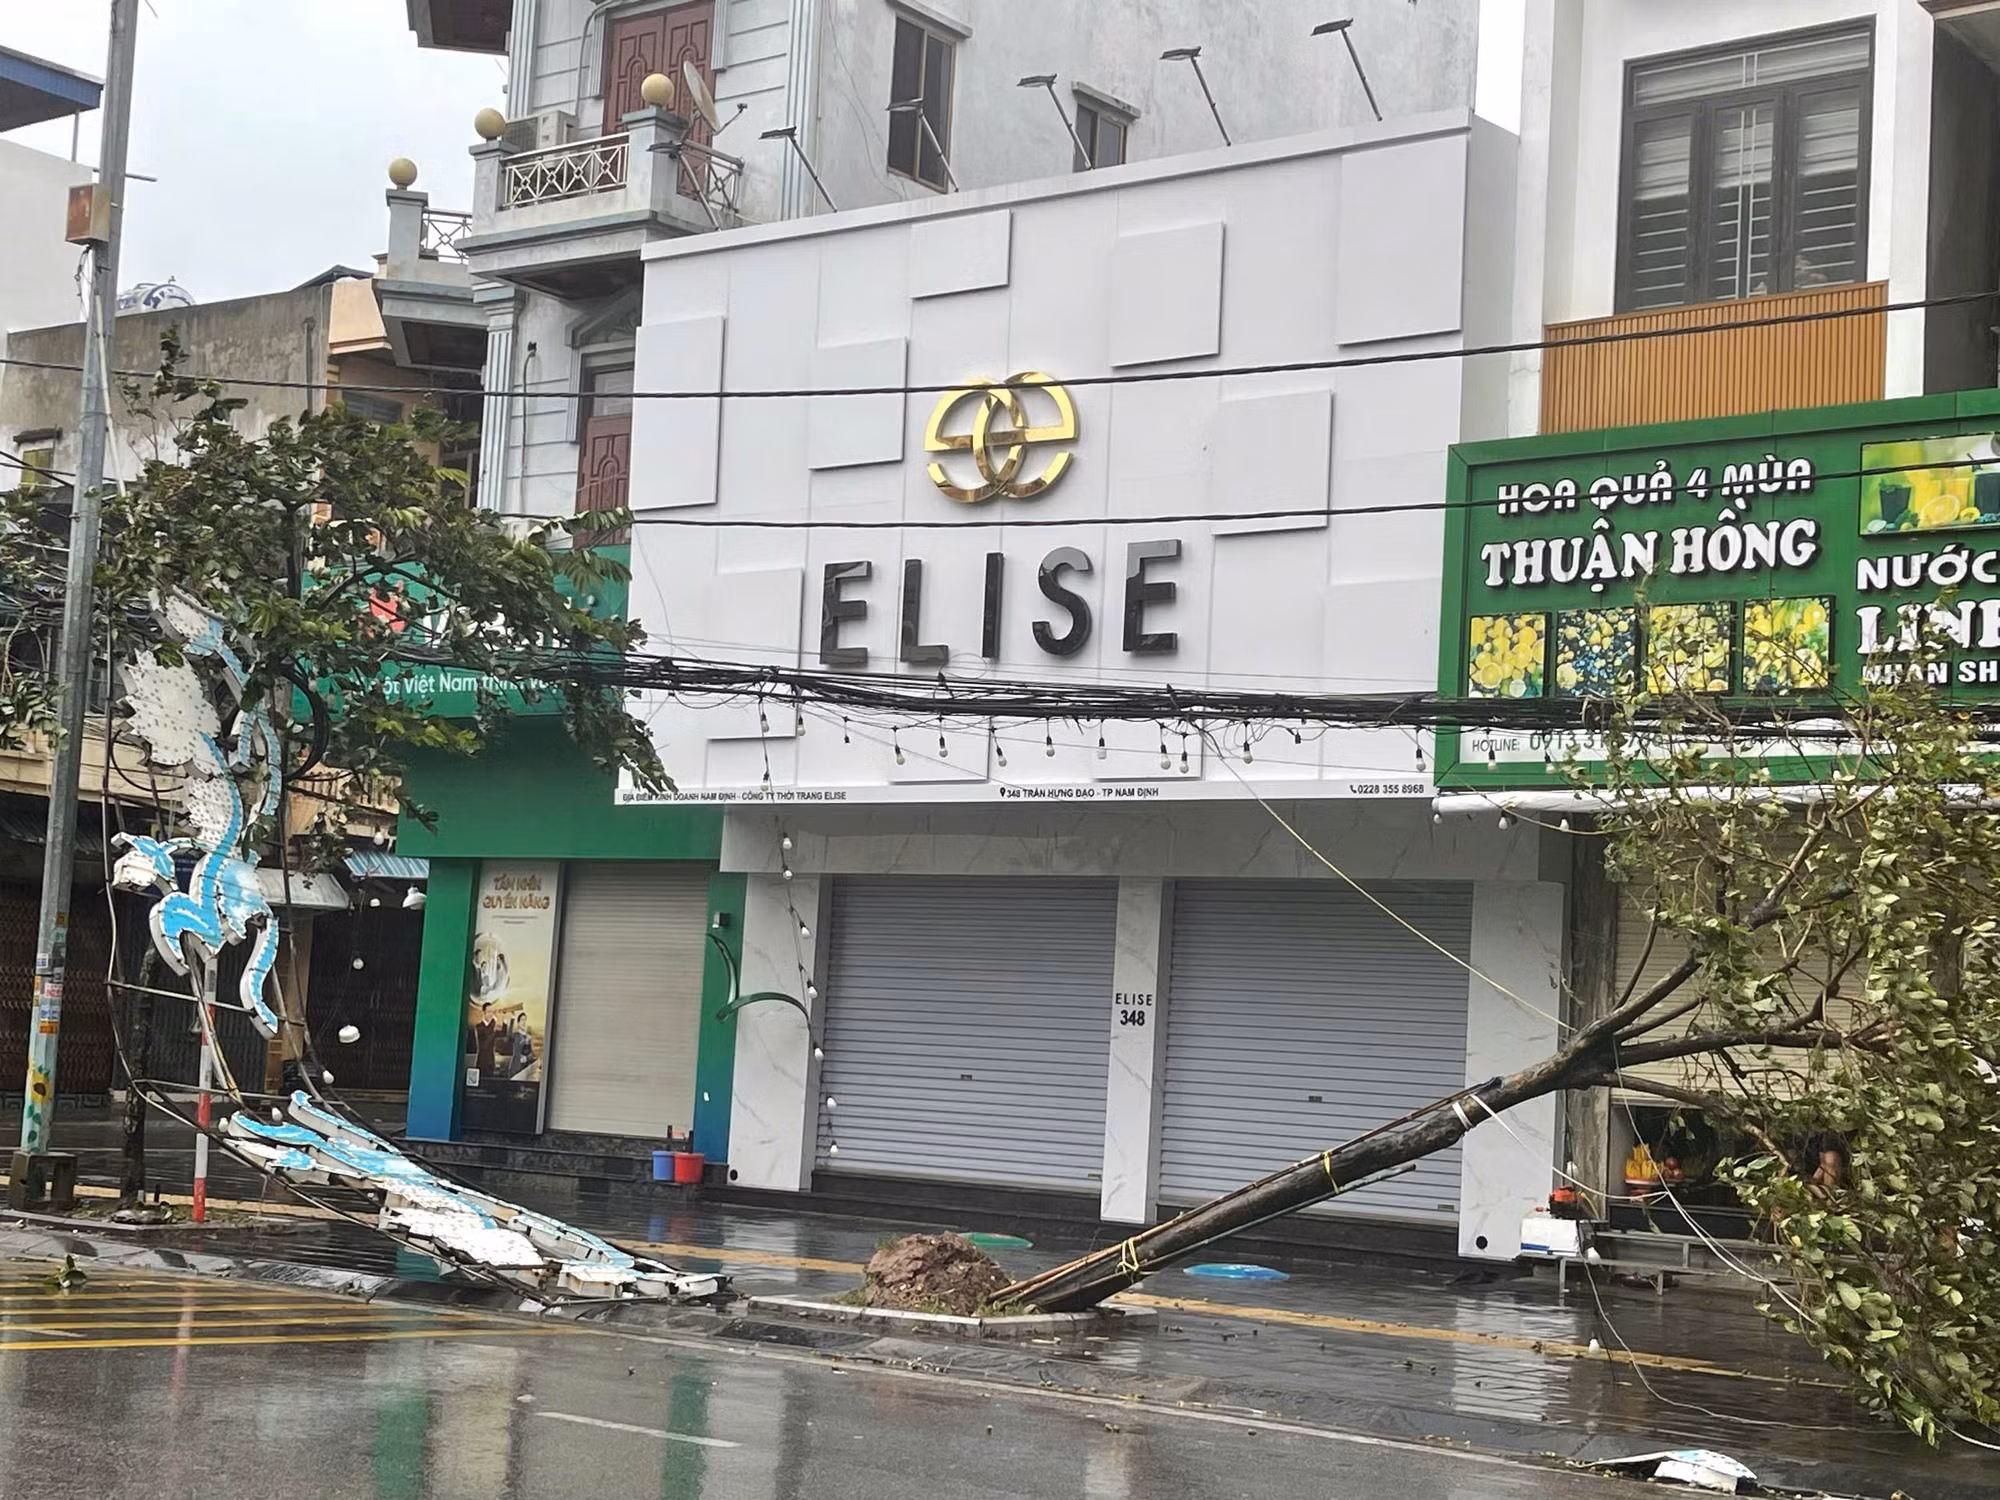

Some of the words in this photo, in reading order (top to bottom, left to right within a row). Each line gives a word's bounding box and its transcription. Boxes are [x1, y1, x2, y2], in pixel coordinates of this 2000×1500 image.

[1498, 478, 1577, 514] HOA
[1589, 460, 1673, 510] QUẢ
[1687, 468, 1709, 498] 4
[1721, 454, 1811, 496] MÙA
[1481, 517, 1658, 593] THUẬN
[1669, 497, 1817, 574] HỒNG
[1857, 544, 1998, 590] NƯỚC
[819, 538, 1182, 665] ELISE
[404, 673, 435, 699] Việt
[439, 673, 478, 693] Nam
[1472, 738, 1521, 752] HOTLINE:
[701, 792, 717, 801] NAM
[741, 789, 764, 801] CÔNG
[765, 791, 776, 801] TY
[796, 791, 823, 801] TRANG
[824, 791, 847, 801] ELISE
[1007, 789, 1021, 798] 348
[1049, 788, 1074, 798] HƯNG
[1102, 787, 1113, 798] TP
[1115, 787, 1135, 797] NAM
[1137, 787, 1159, 799] ĐỊNH
[1357, 784, 1380, 794] 0228
[1382, 784, 1399, 794] 355
[1115, 992, 1153, 1007] ELISE
[1120, 1009, 1146, 1026] 348
